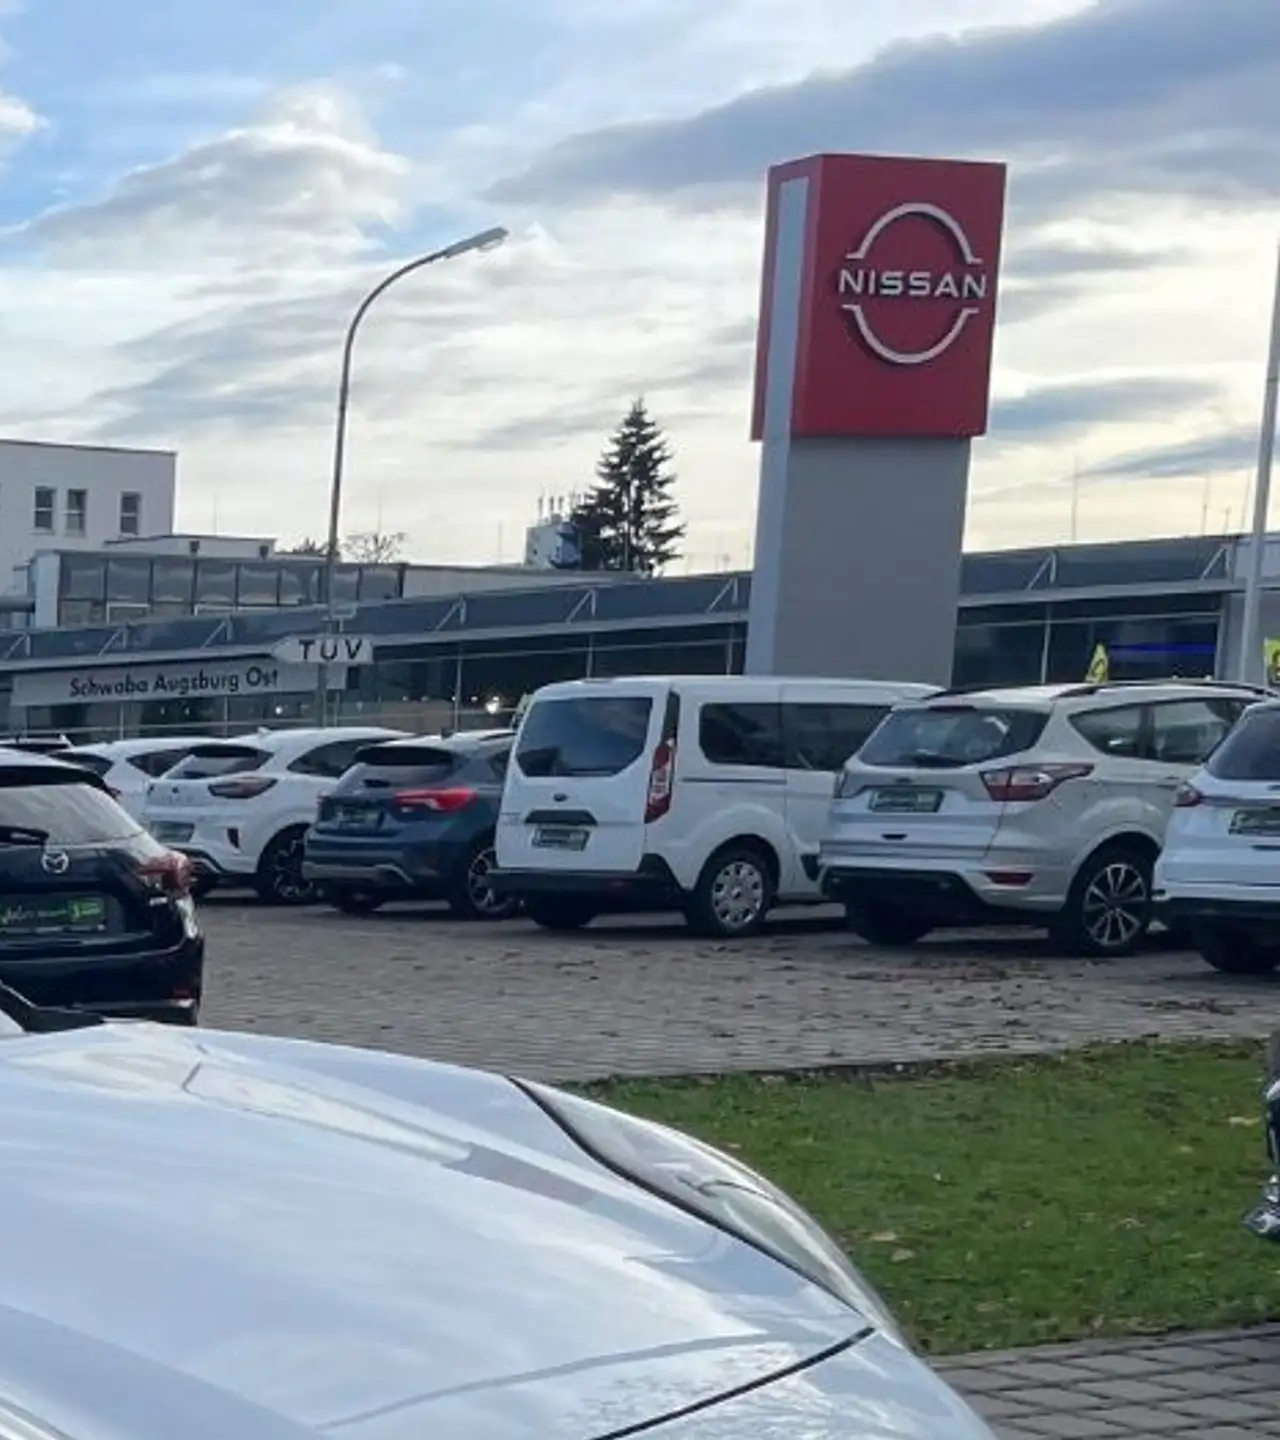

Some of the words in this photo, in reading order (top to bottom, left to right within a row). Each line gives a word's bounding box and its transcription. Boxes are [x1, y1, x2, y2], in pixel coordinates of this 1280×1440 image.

[839, 269, 987, 299] NISSAN
[70, 674, 148, 697] Schwaba
[153, 669, 239, 695] Augsburg
[246, 667, 278, 687] Ost
